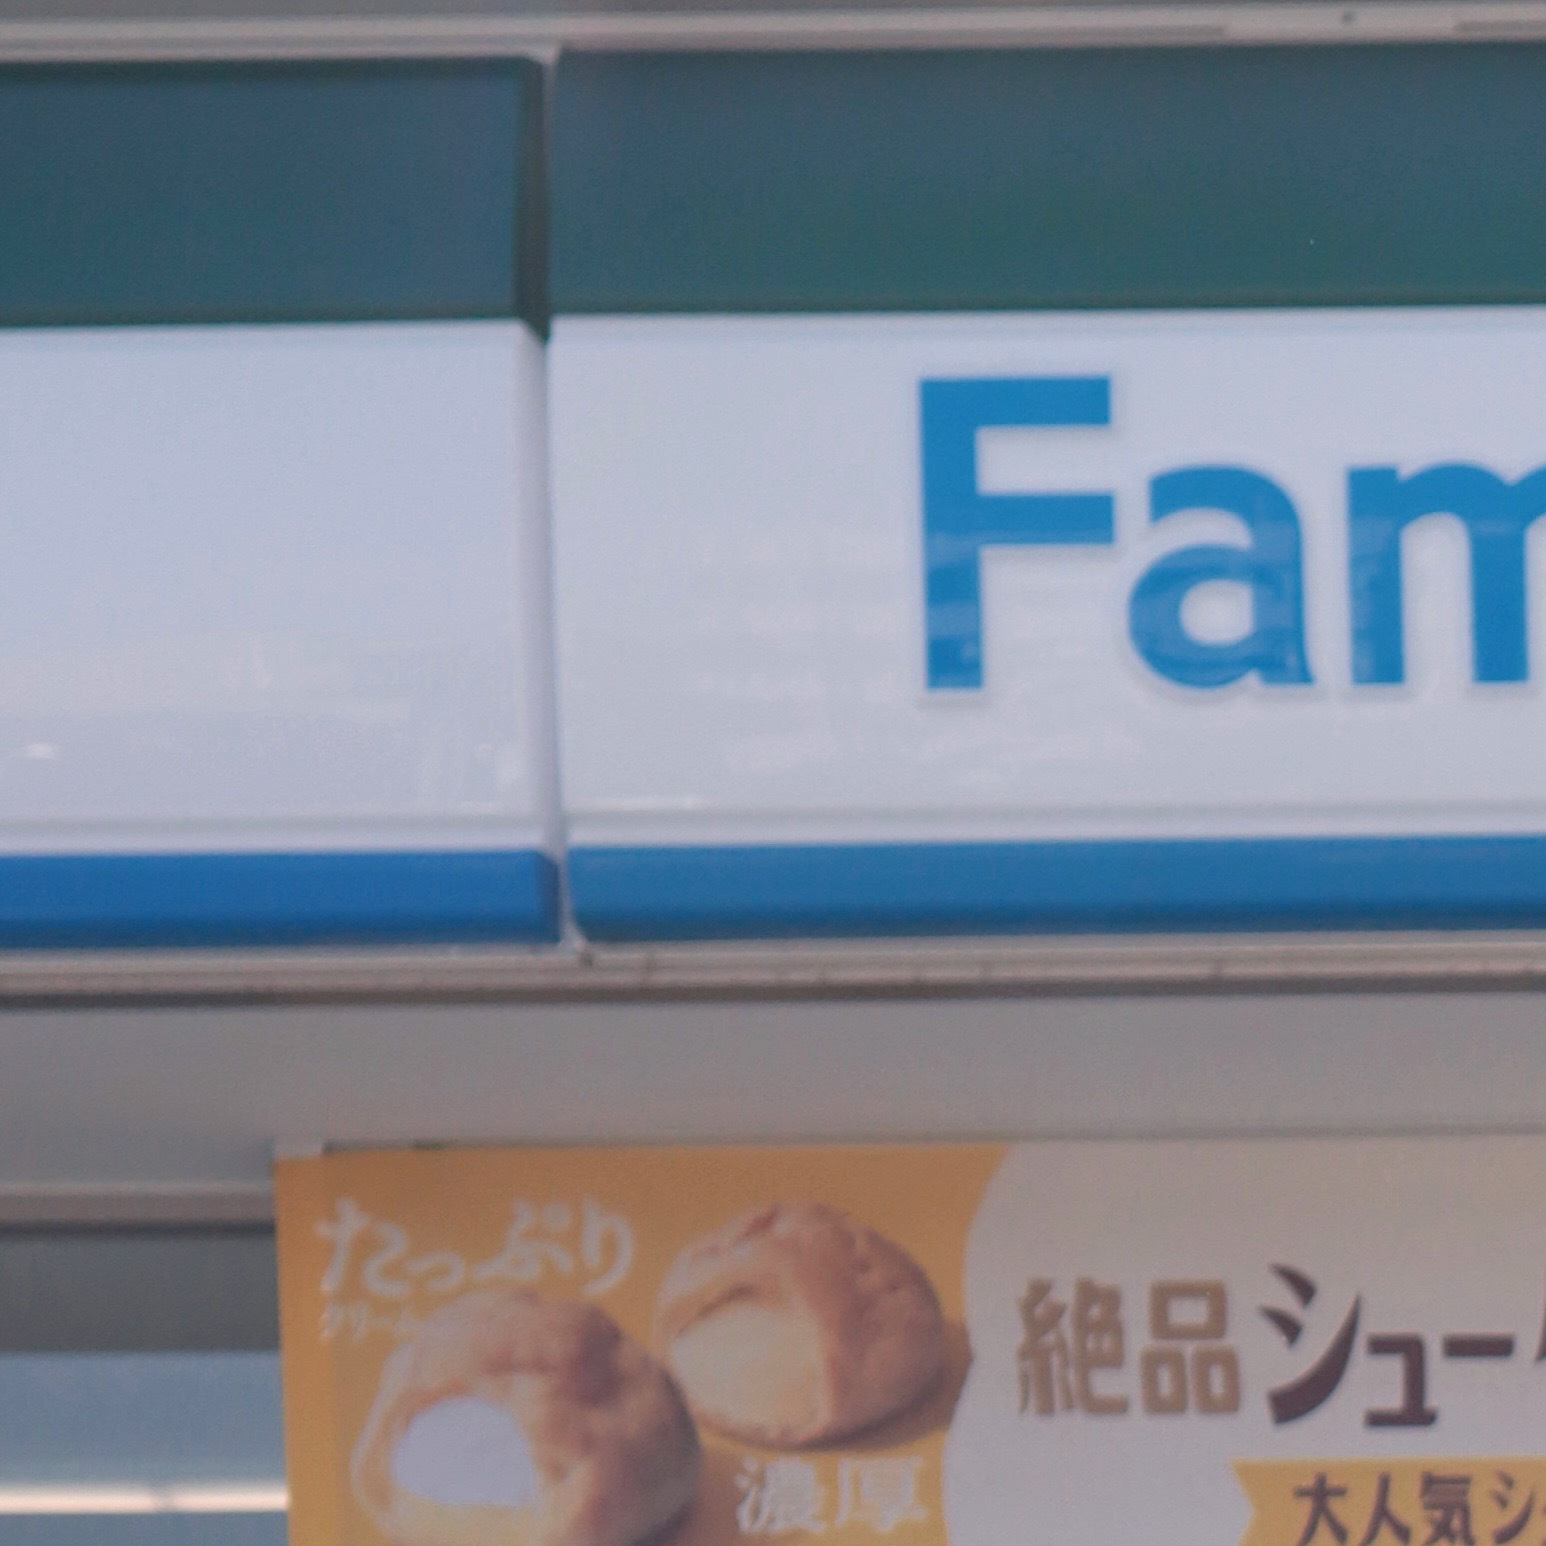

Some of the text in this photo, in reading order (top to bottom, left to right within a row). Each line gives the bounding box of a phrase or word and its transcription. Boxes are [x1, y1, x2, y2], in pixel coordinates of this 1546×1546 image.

[314, 1196, 636, 1298] たっぷり
[736, 1454, 928, 1536] 濃厚
